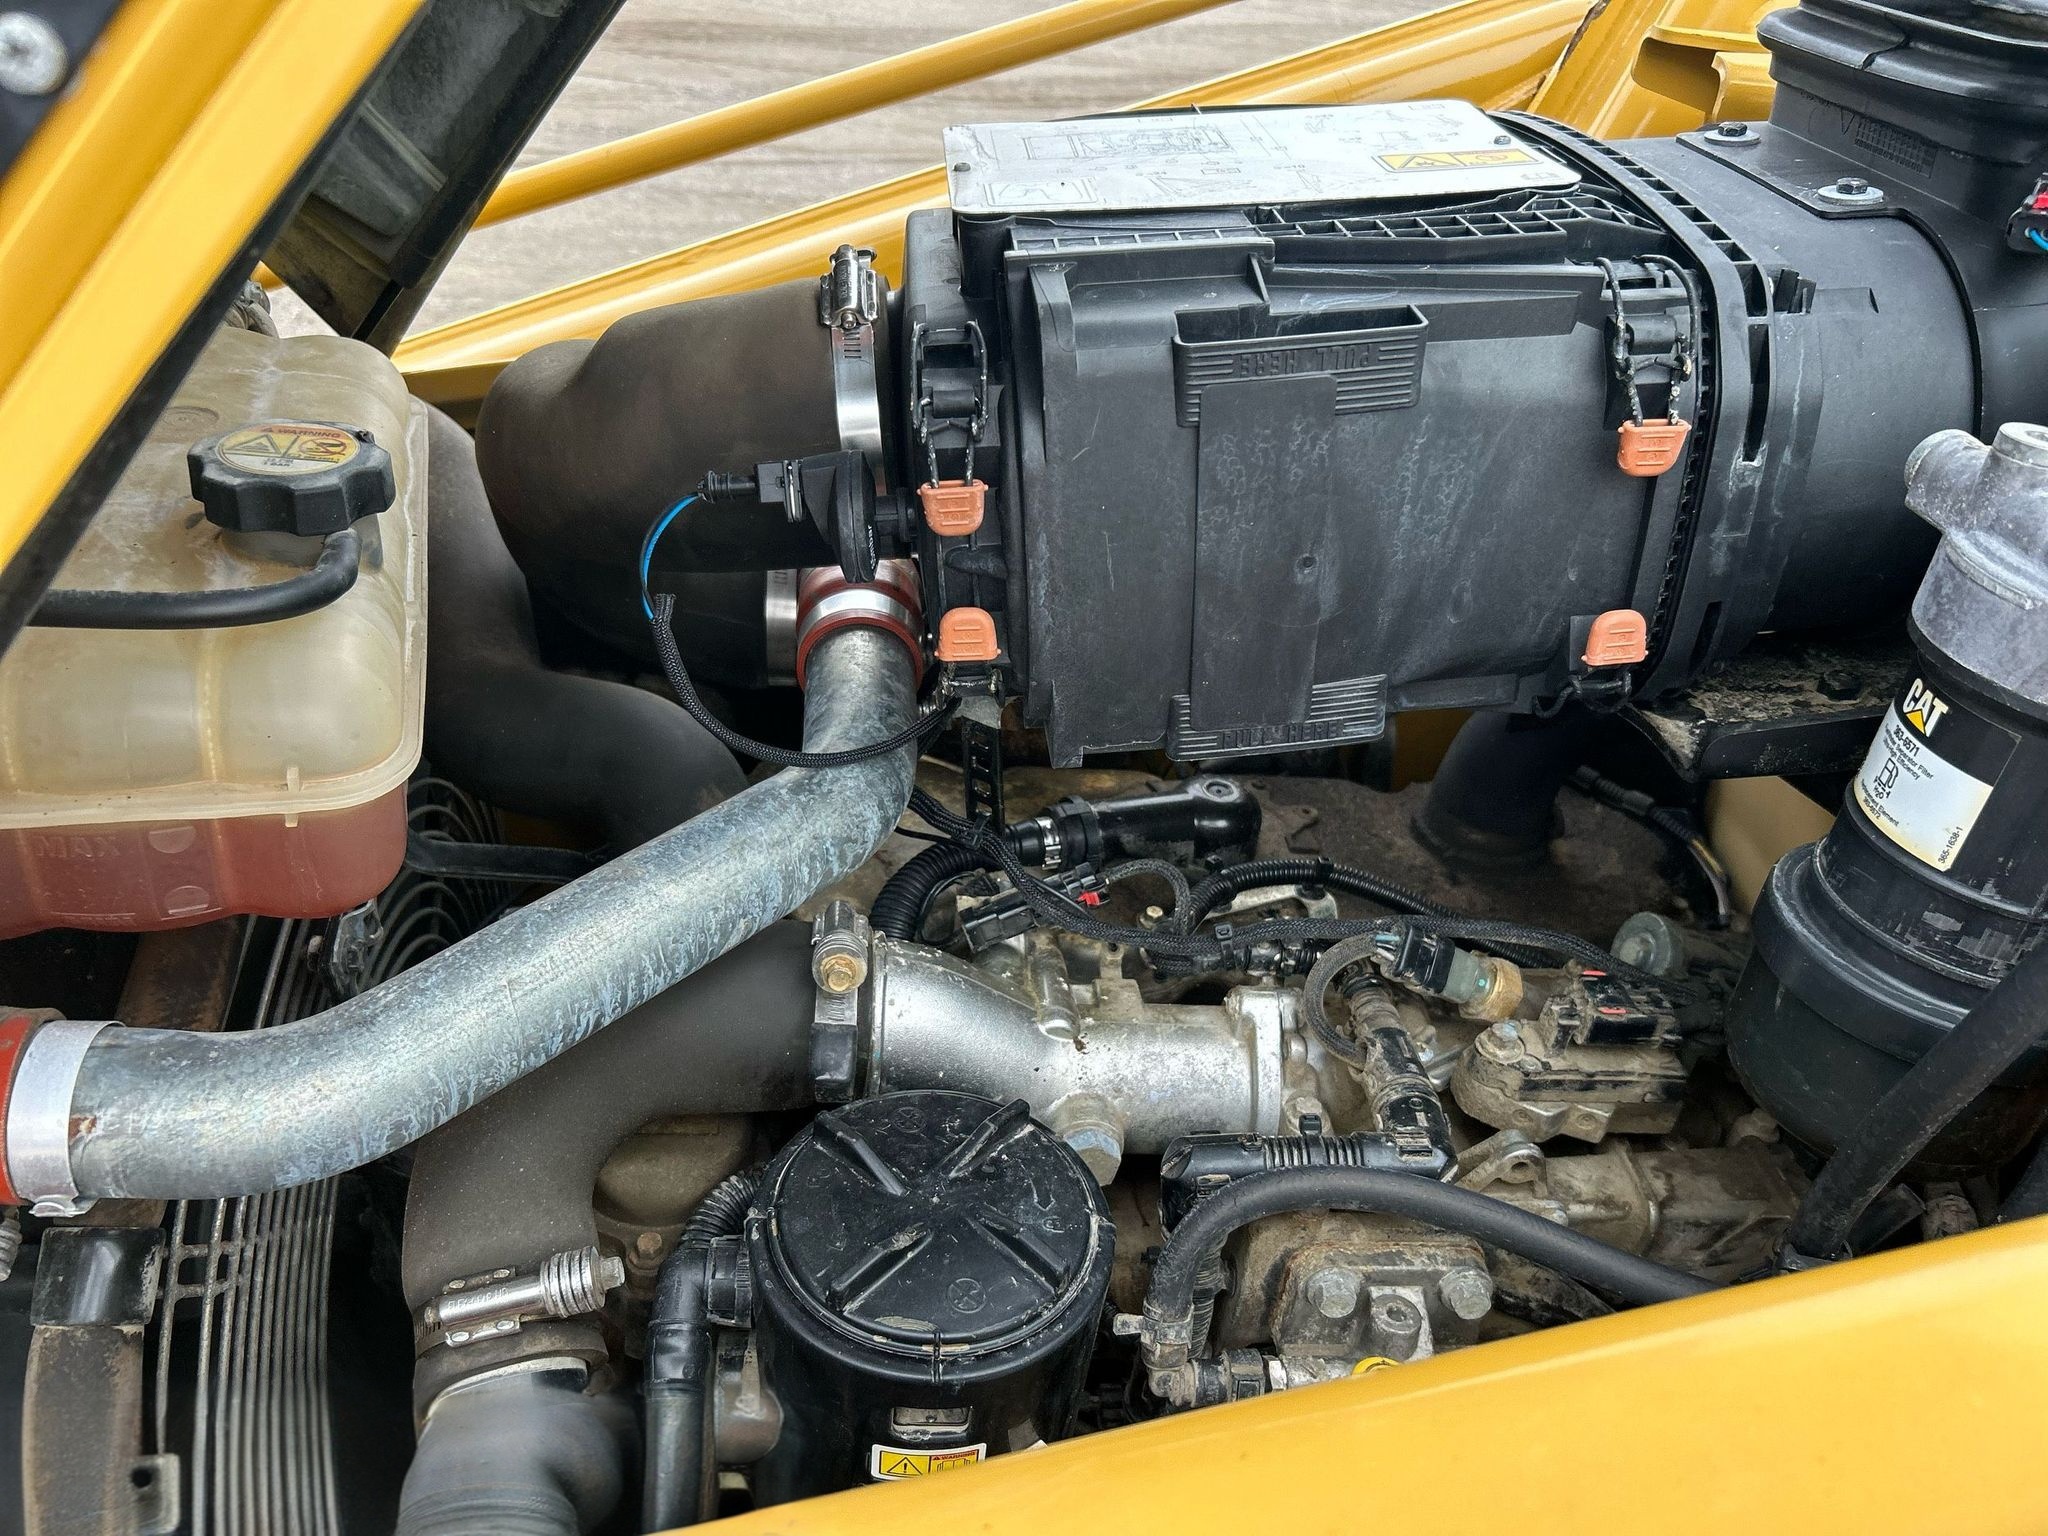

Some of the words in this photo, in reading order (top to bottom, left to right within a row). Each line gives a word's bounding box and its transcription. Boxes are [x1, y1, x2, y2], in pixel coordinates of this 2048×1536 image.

[1239, 350, 1297, 376] HERE
[1315, 344, 1372, 372] PULL
[278, 429, 341, 438] WARNING
[1902, 677, 1949, 738] CAT
[1287, 720, 1339, 743] HERE
[1917, 764, 1934, 779] Filter
[1878, 804, 1900, 827] Element
[1937, 826, 1964, 864] 365-1638-1
[941, 1451, 976, 1461] WARNING
